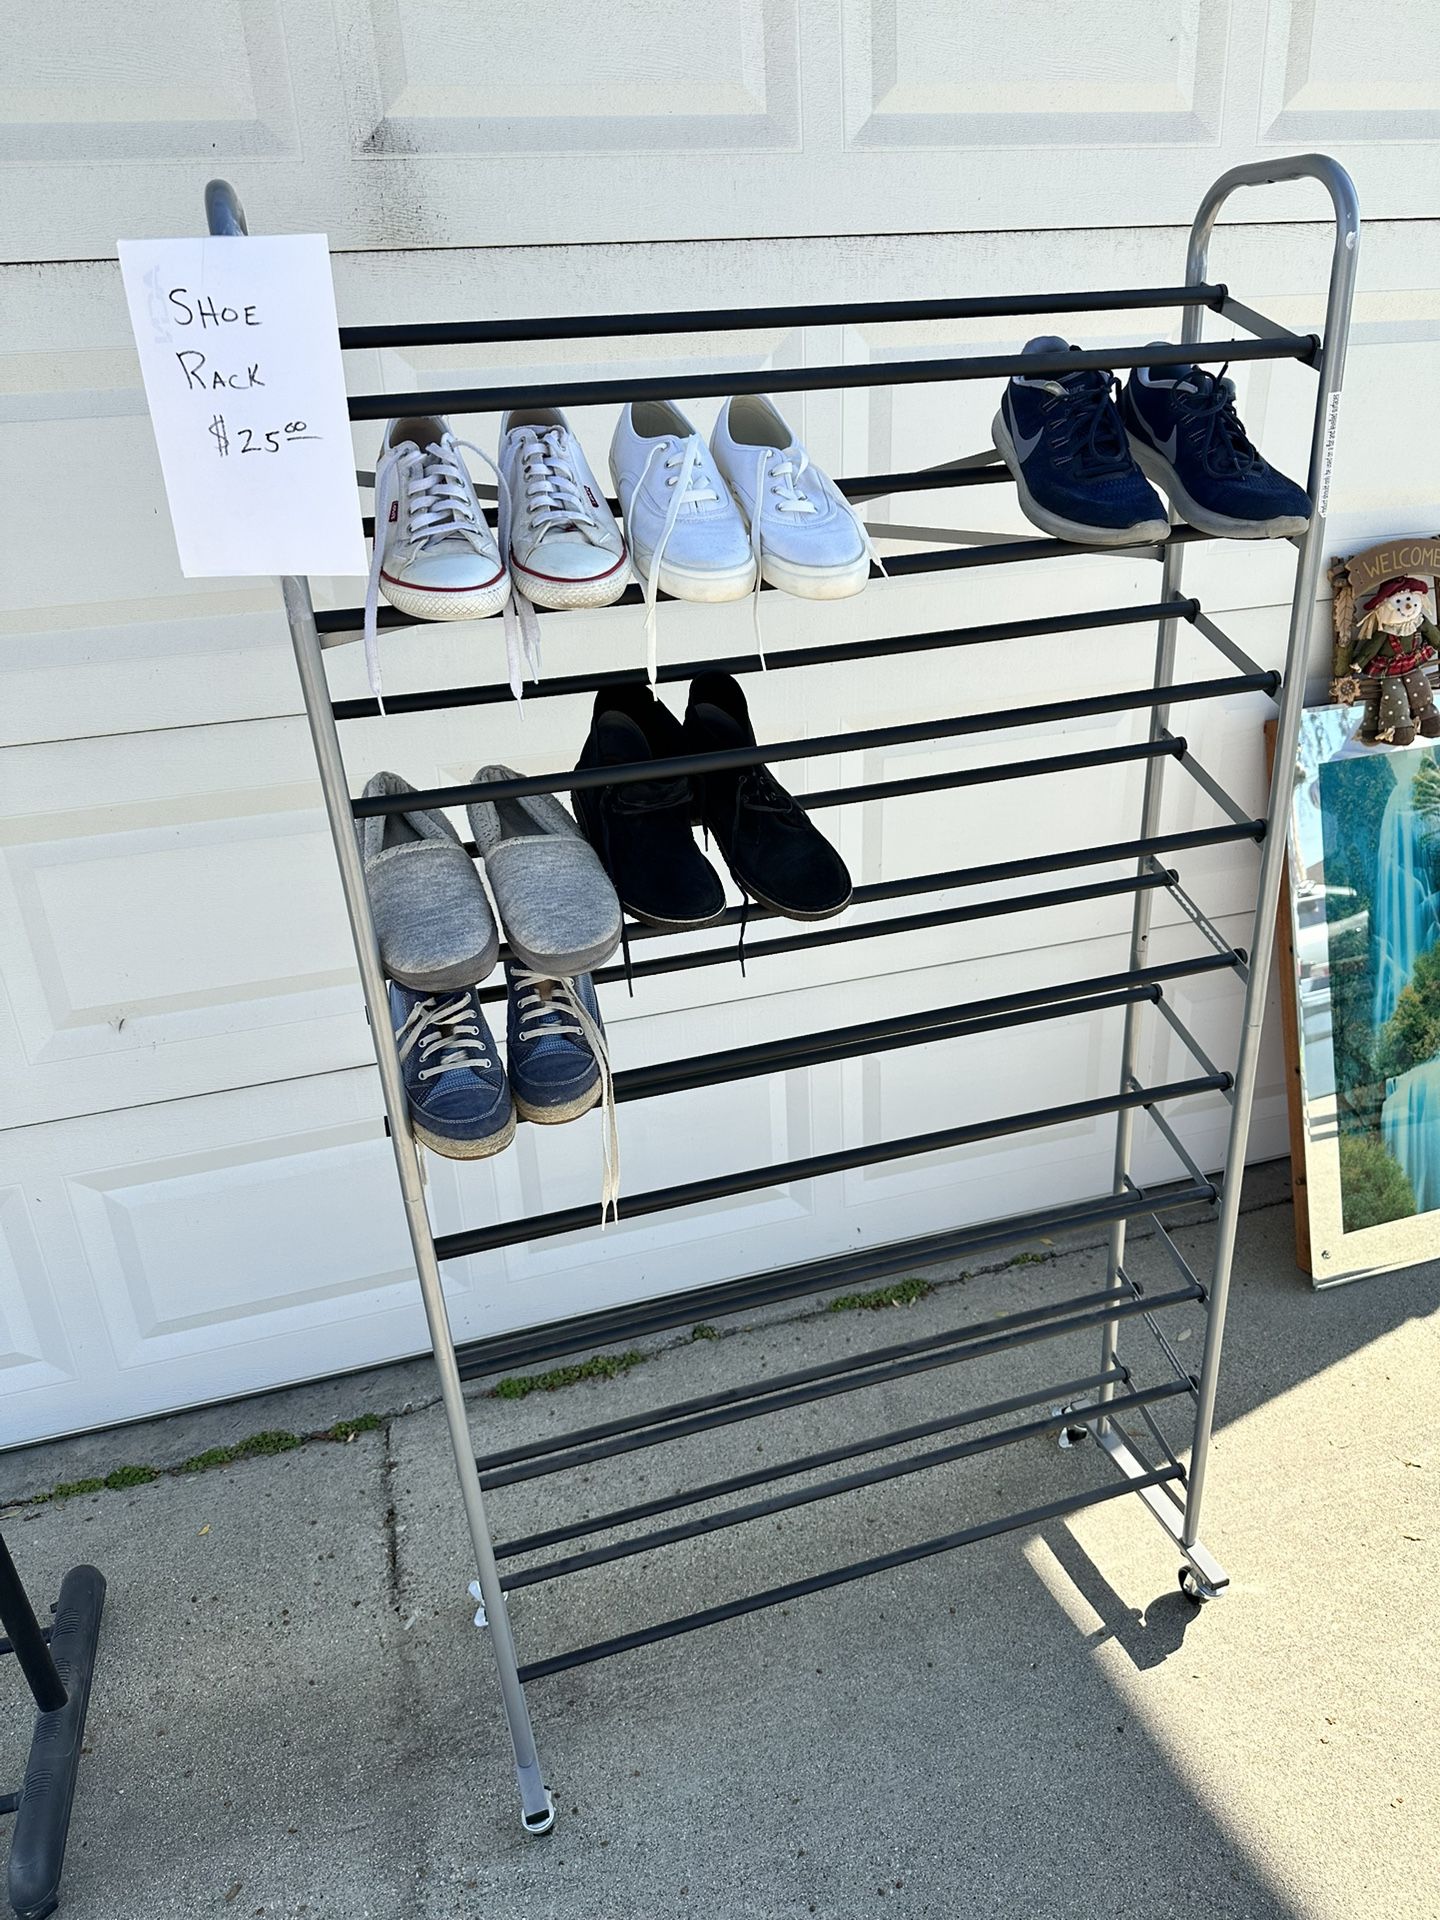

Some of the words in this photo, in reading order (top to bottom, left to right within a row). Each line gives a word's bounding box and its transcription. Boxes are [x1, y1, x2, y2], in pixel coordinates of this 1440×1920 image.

[168, 287, 263, 329] SHOE
[175, 350, 266, 390] RACK
[1362, 546, 1440, 578] WELCOME
